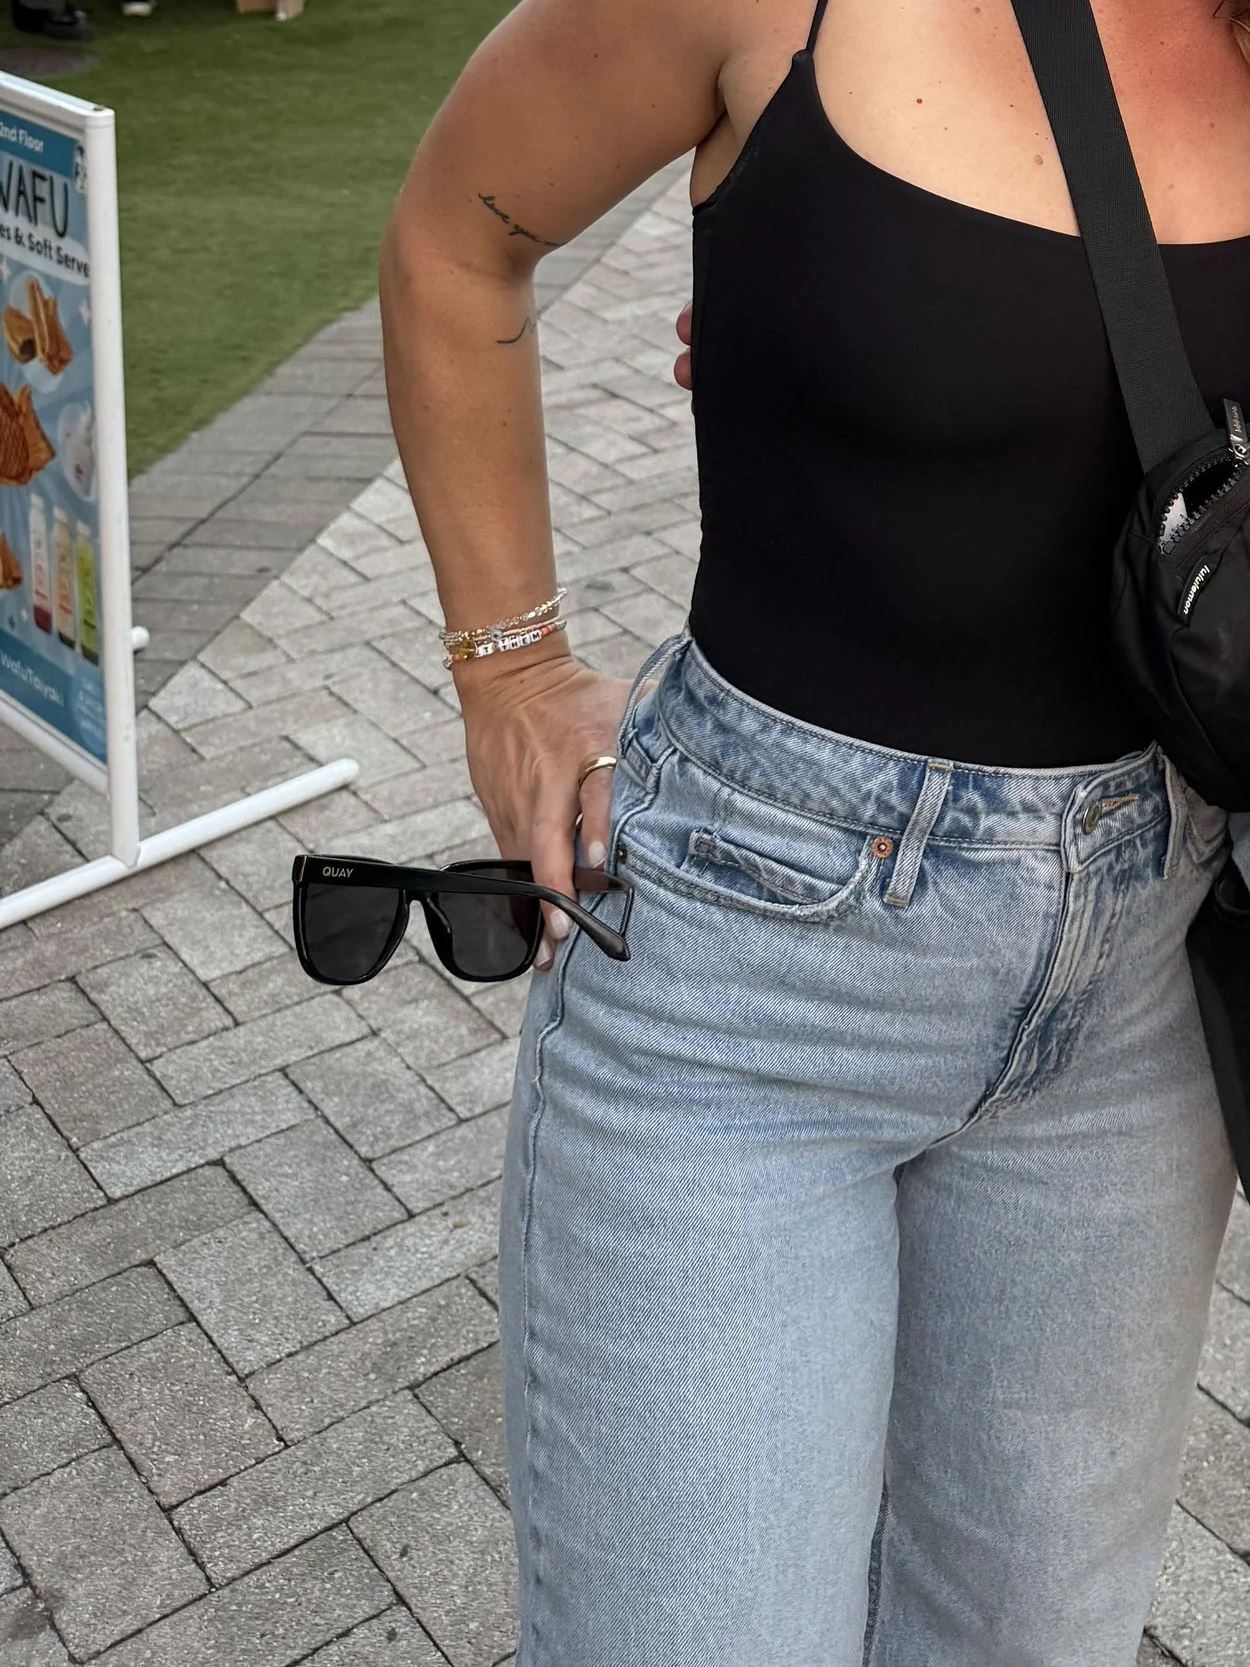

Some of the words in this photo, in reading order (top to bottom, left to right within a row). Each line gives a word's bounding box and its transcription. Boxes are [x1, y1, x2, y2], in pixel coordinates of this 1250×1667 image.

[19, 128, 44, 152] Floor
[15, 226, 26, 248] &
[29, 232, 53, 262] Soft
[56, 246, 90, 278] Serve
[1183, 564, 1210, 615] lululemon
[322, 866, 354, 878] QUAY
